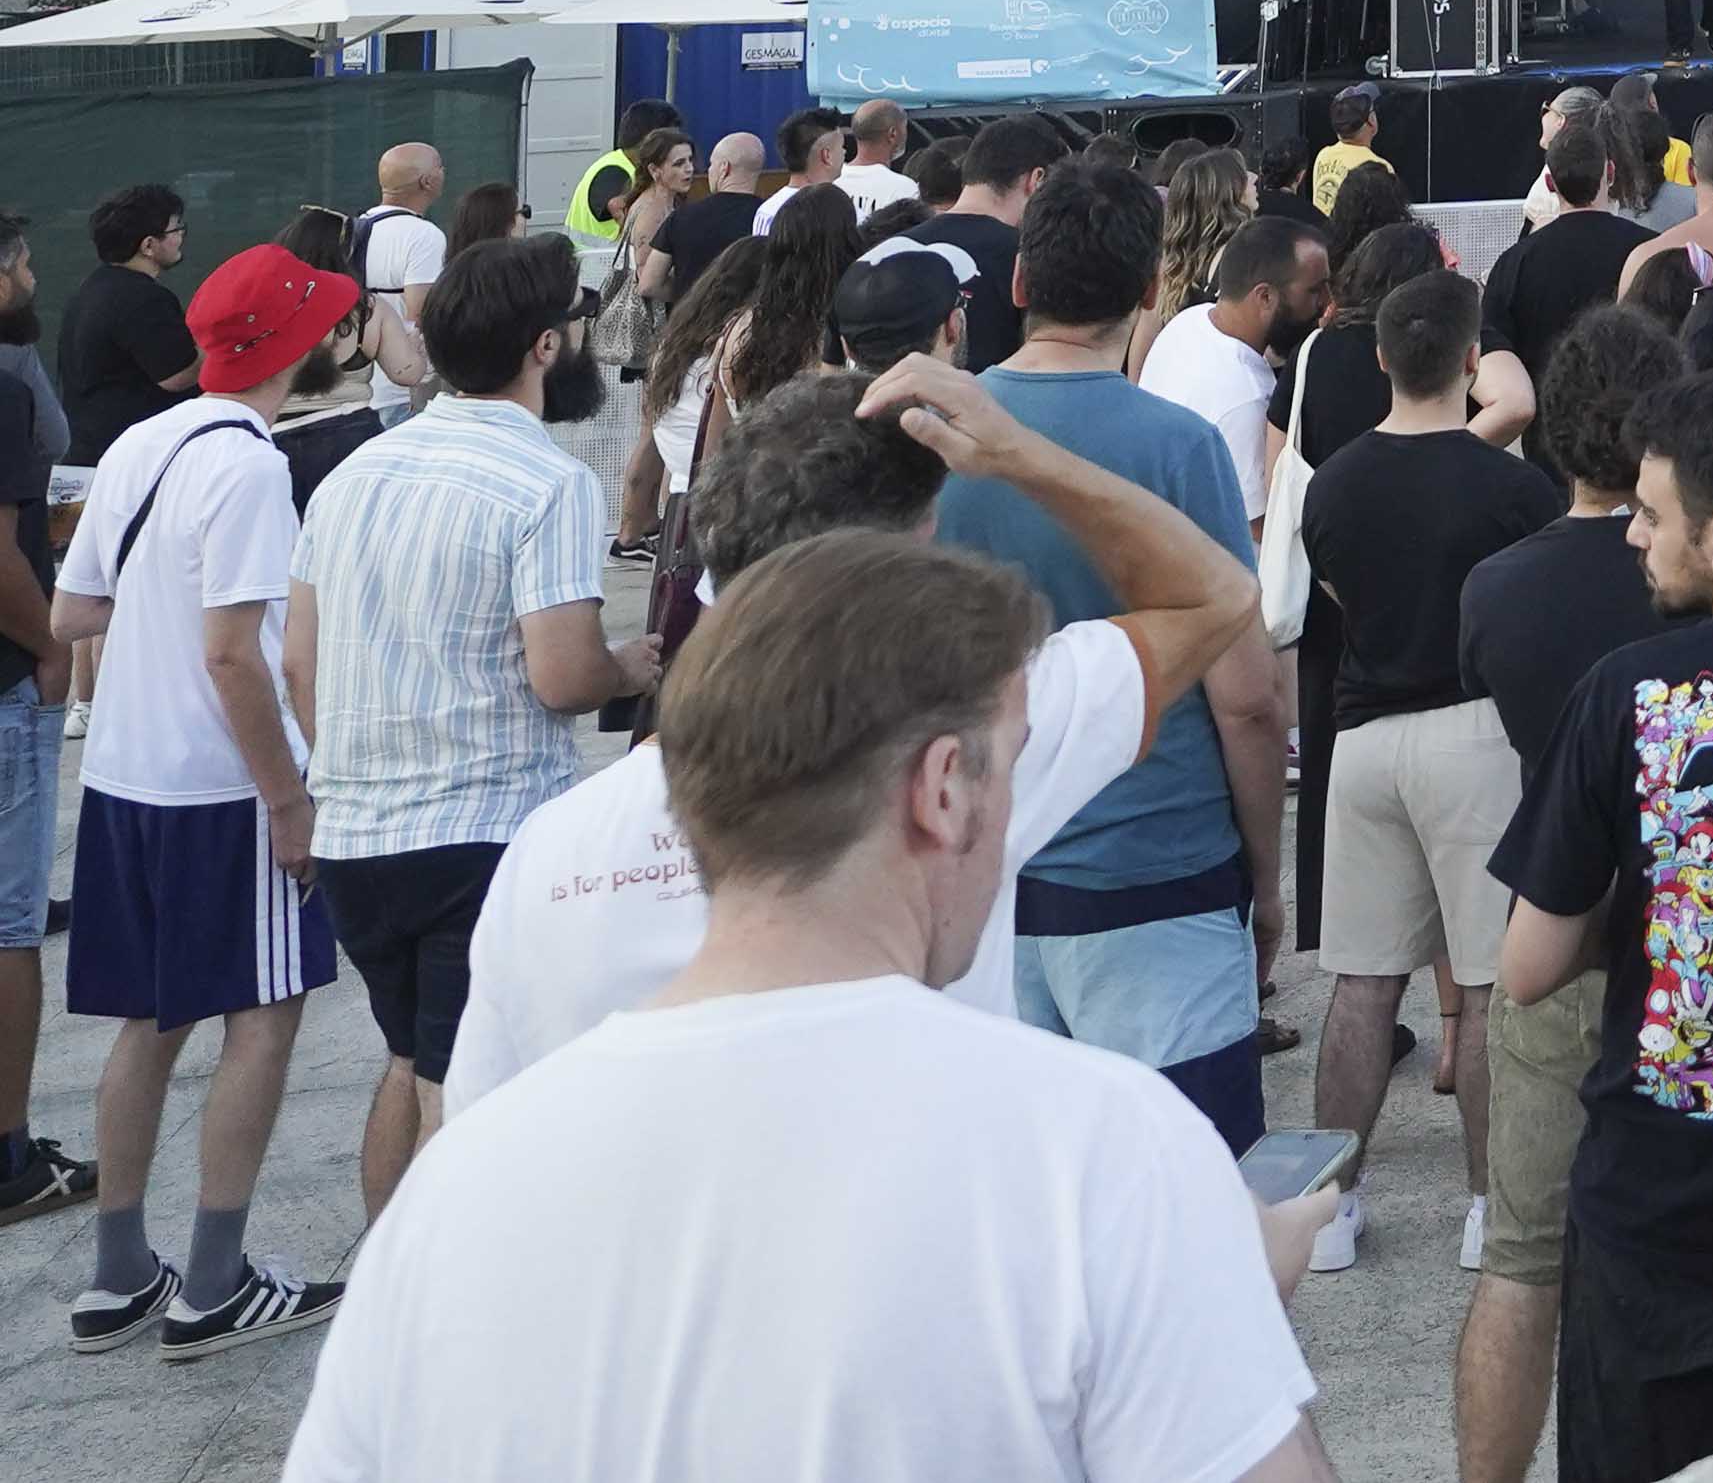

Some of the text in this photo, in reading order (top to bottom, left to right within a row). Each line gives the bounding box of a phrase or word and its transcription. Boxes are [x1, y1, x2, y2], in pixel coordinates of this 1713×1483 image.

[745, 47, 800, 60] GESMAGAL
[551, 856, 699, 902] is for people
